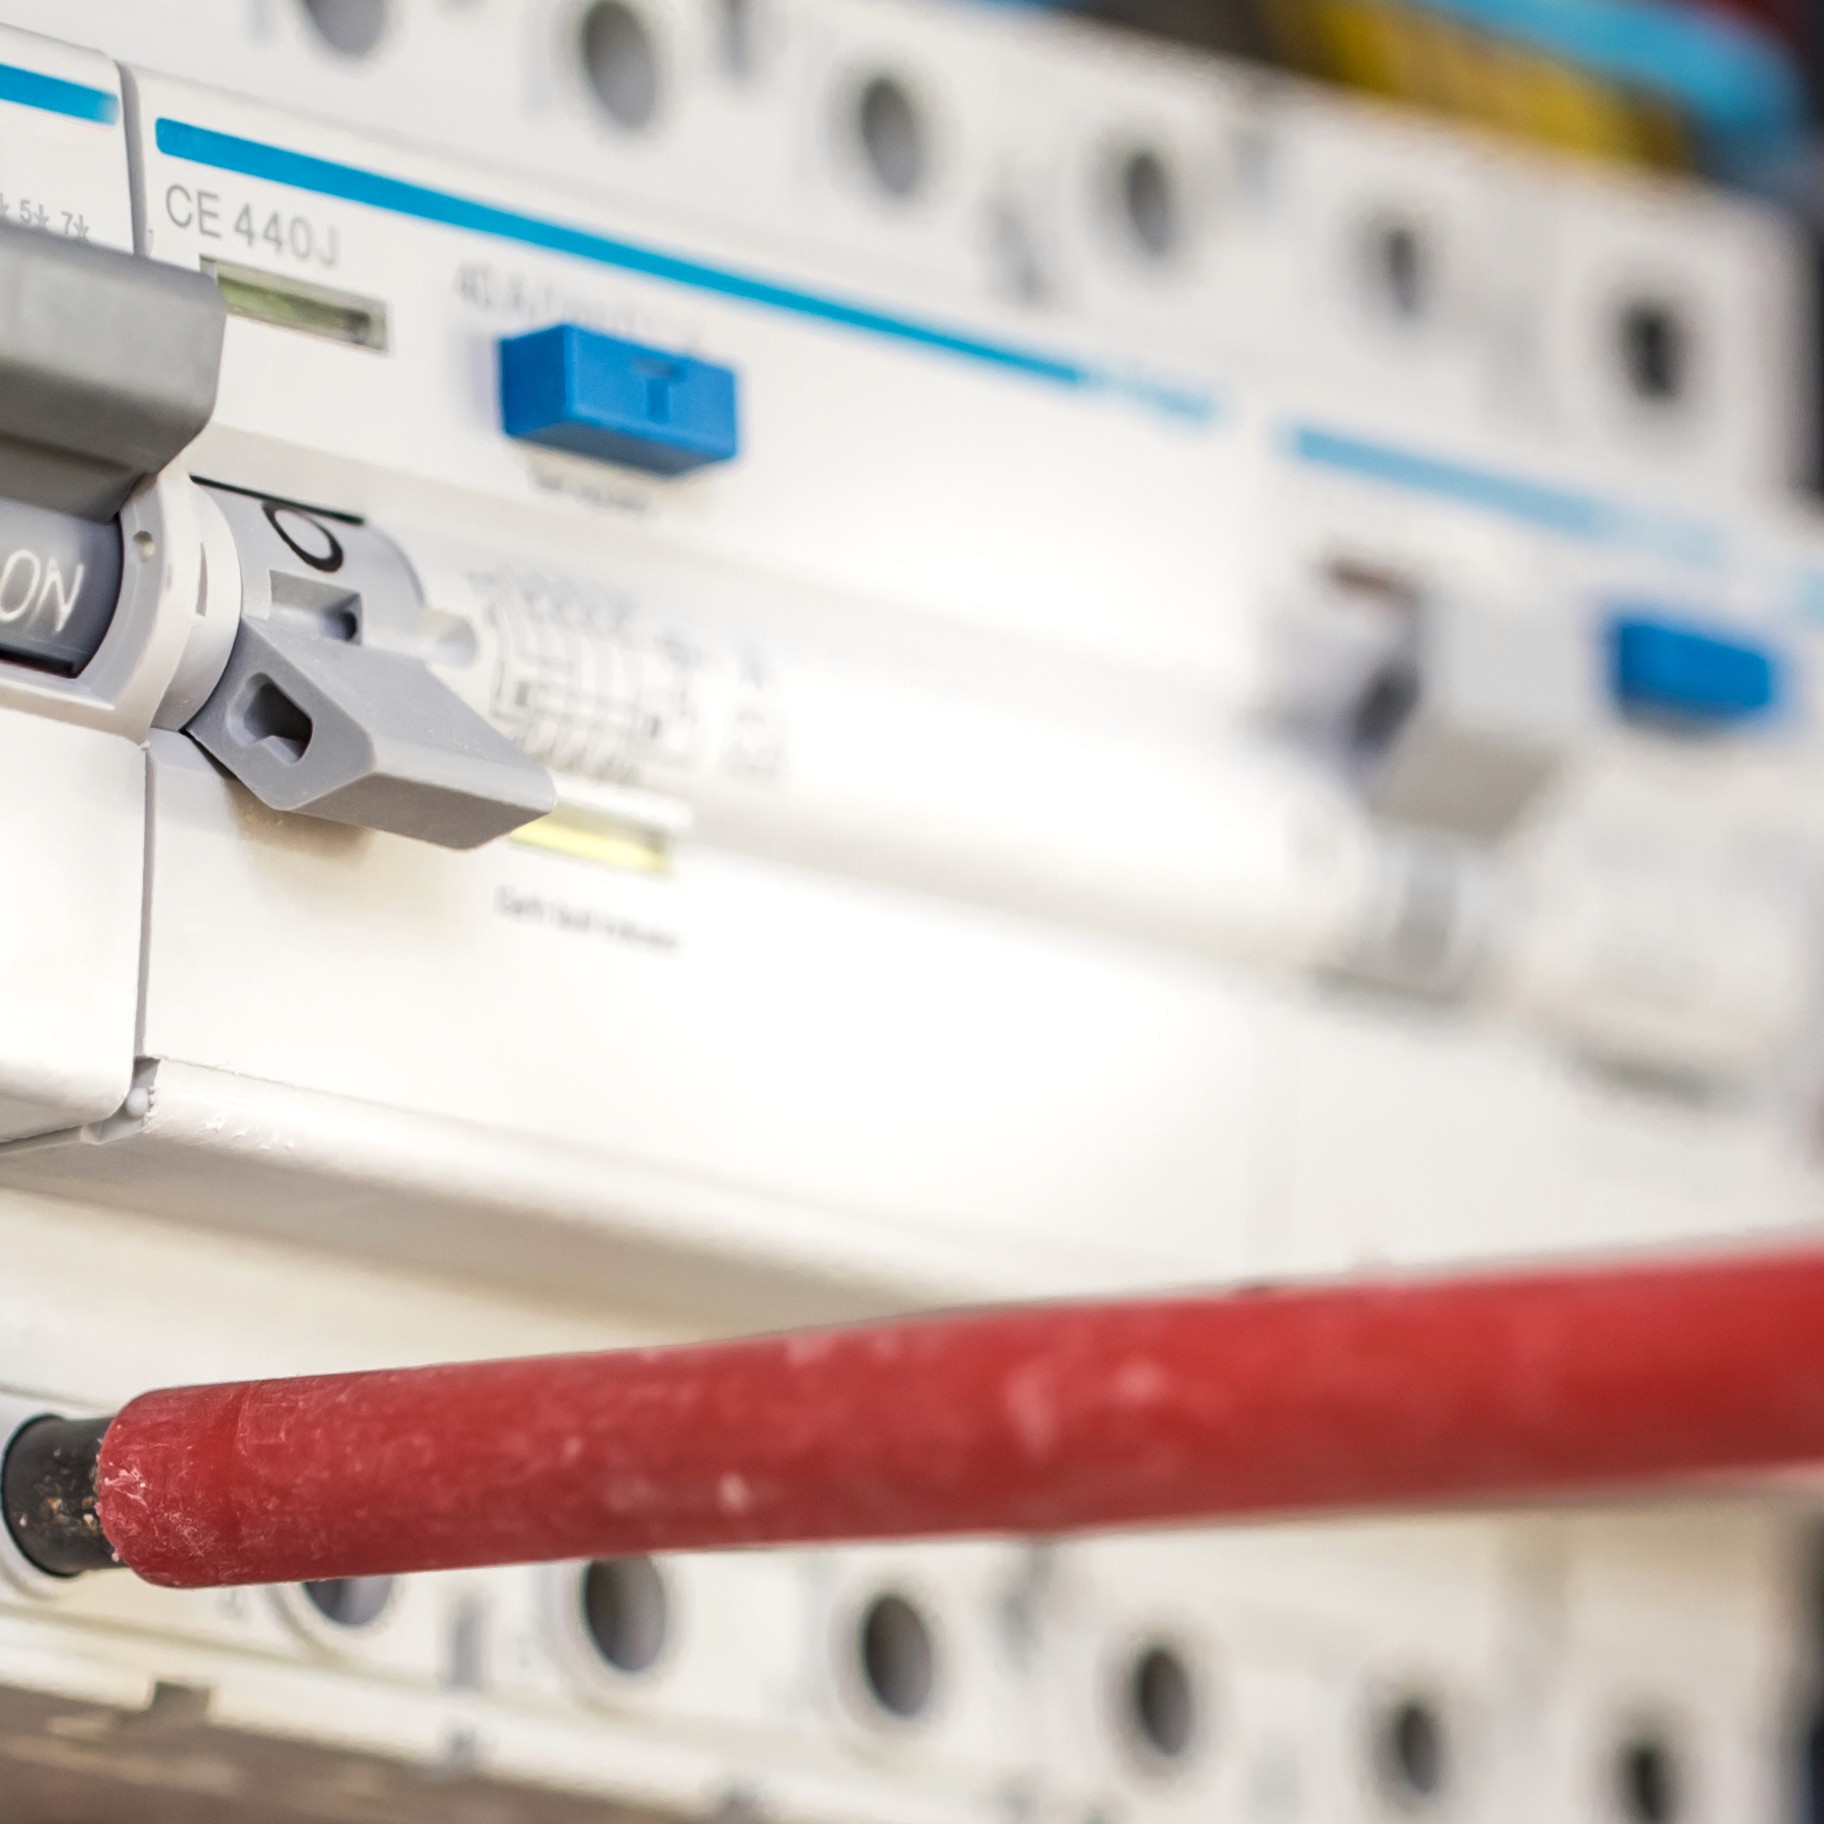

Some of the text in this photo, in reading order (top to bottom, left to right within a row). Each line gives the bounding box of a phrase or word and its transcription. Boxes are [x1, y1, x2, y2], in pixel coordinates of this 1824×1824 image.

[20, 199, 33, 225] 5
[61, 211, 74, 235] 7
[165, 184, 341, 268] CE 440J
